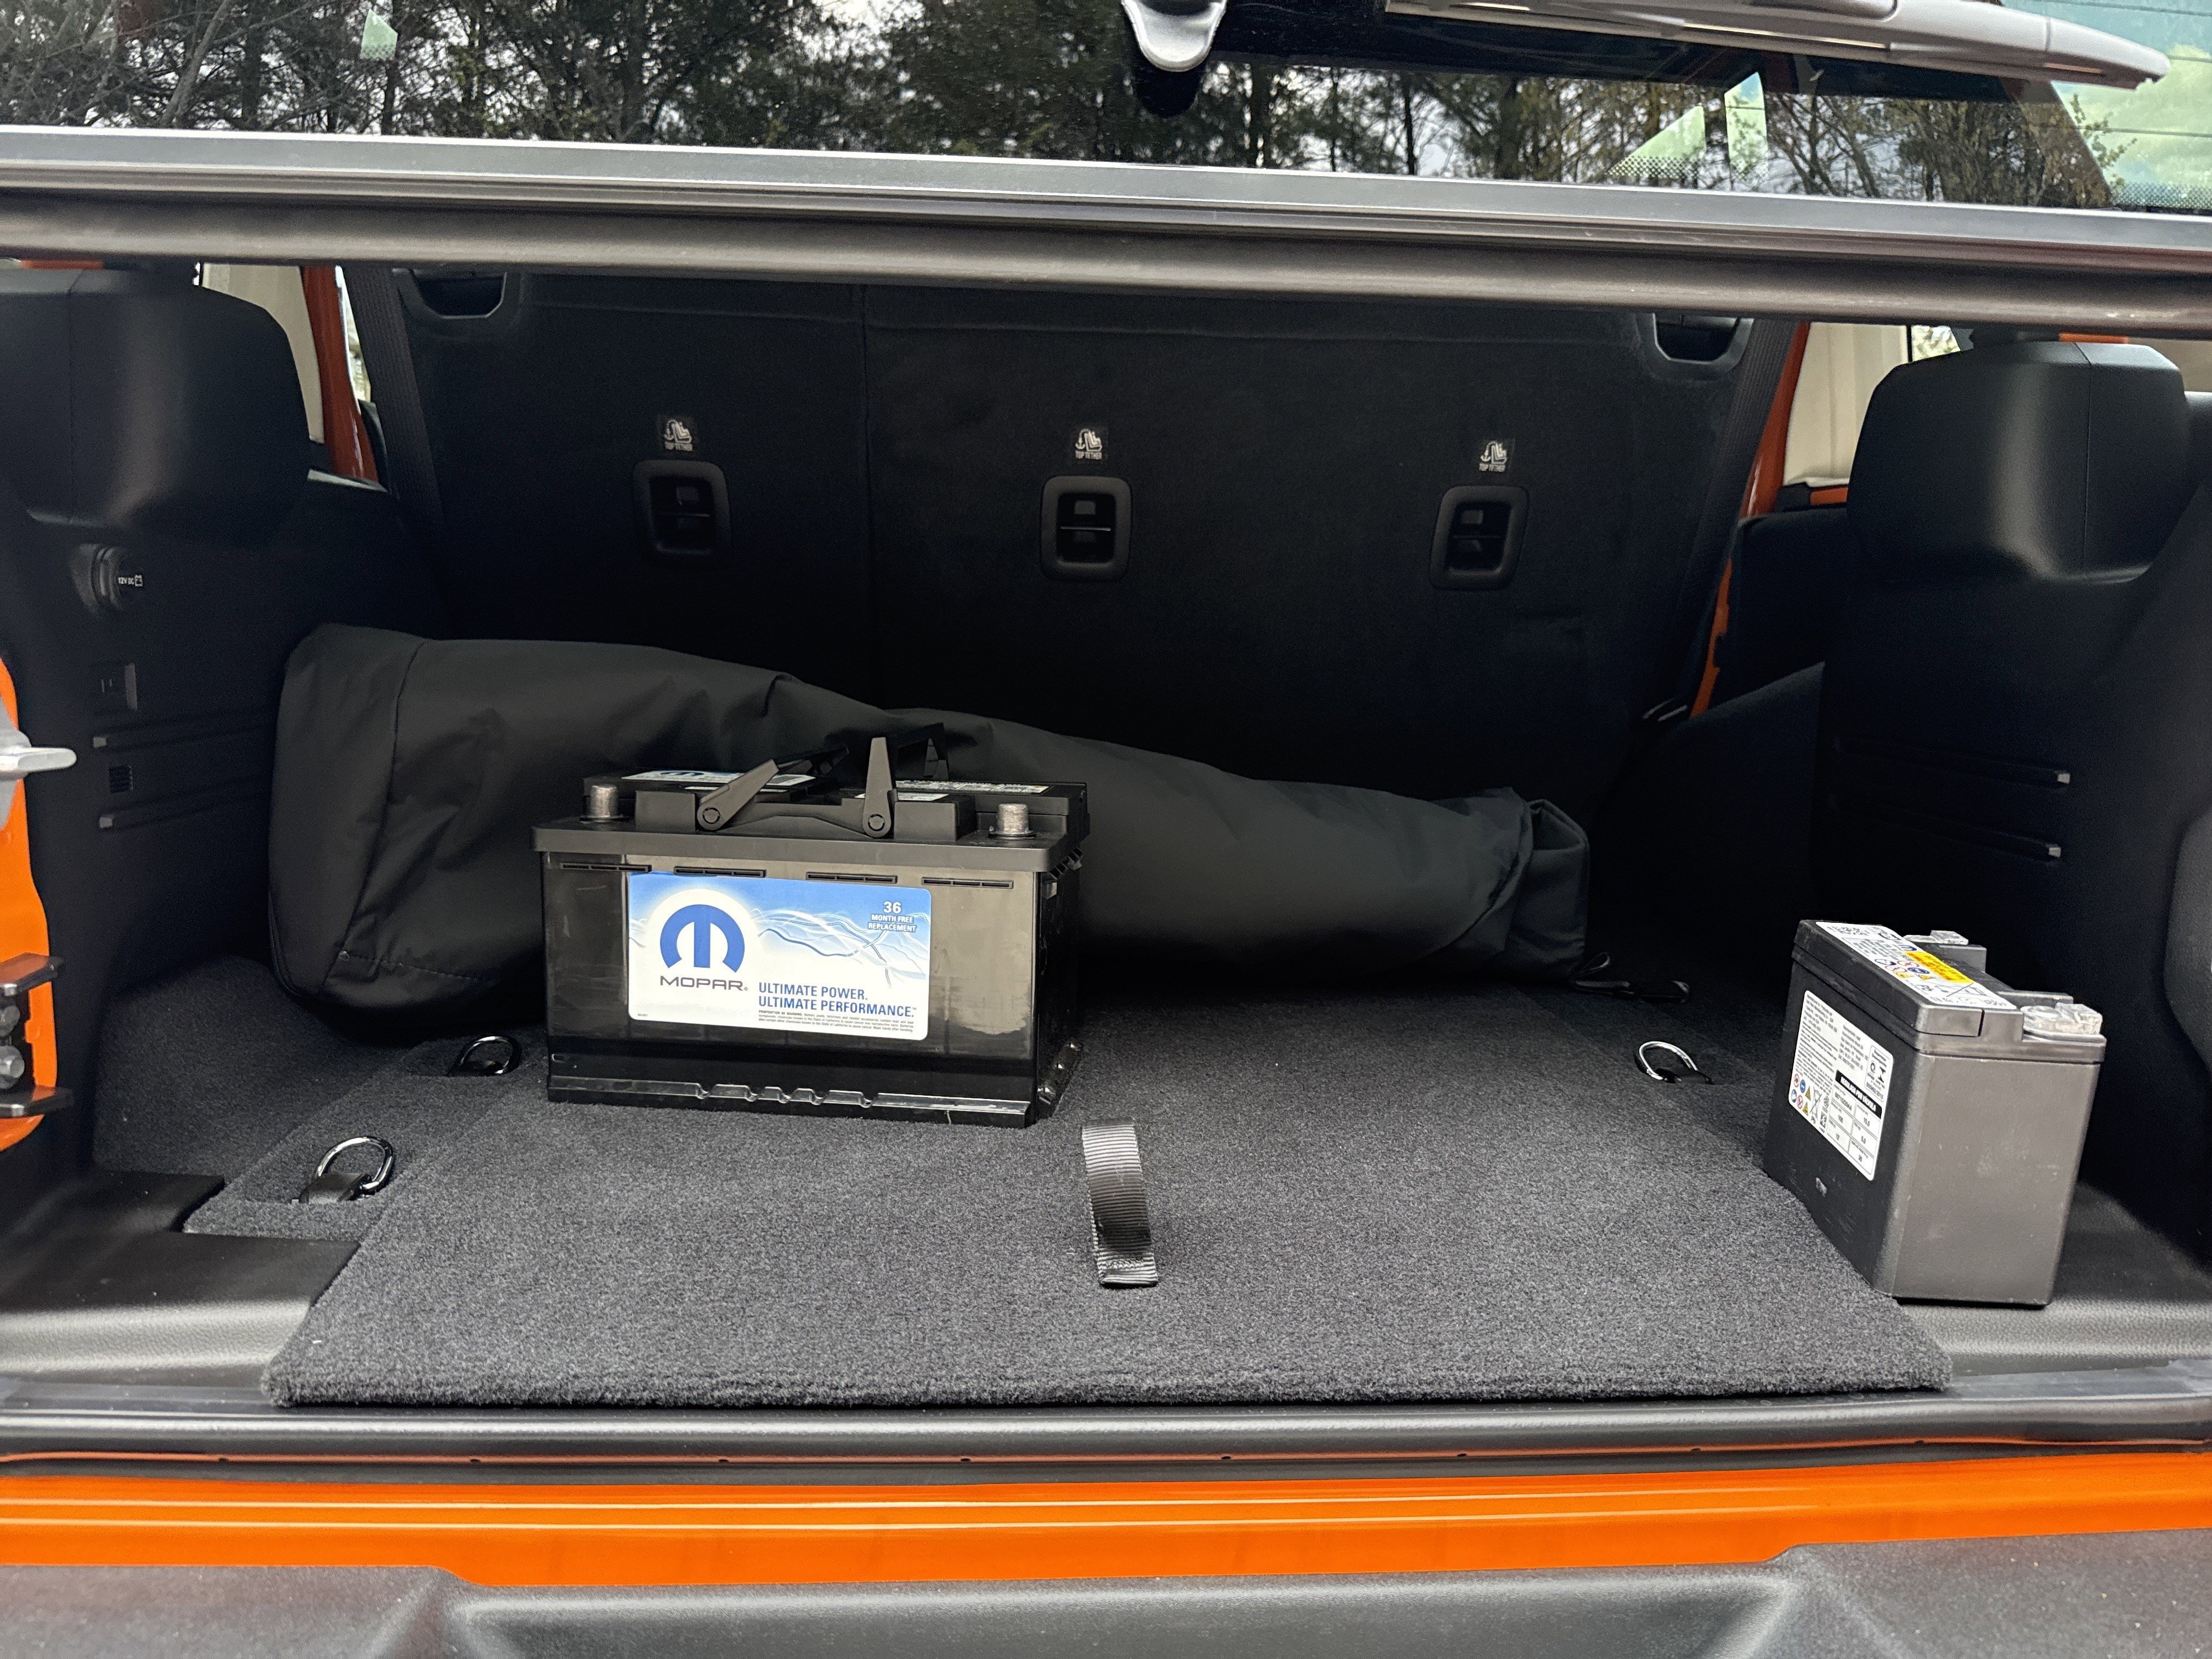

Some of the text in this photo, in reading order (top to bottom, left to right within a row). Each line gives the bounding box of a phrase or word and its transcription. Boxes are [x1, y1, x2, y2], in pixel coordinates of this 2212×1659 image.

[883, 901, 901, 914] 36
[868, 923, 916, 932] REPLACEMENT
[759, 982, 868, 1001] ULTIMATE POWER.
[759, 996, 817, 1010] ULTIMATE
